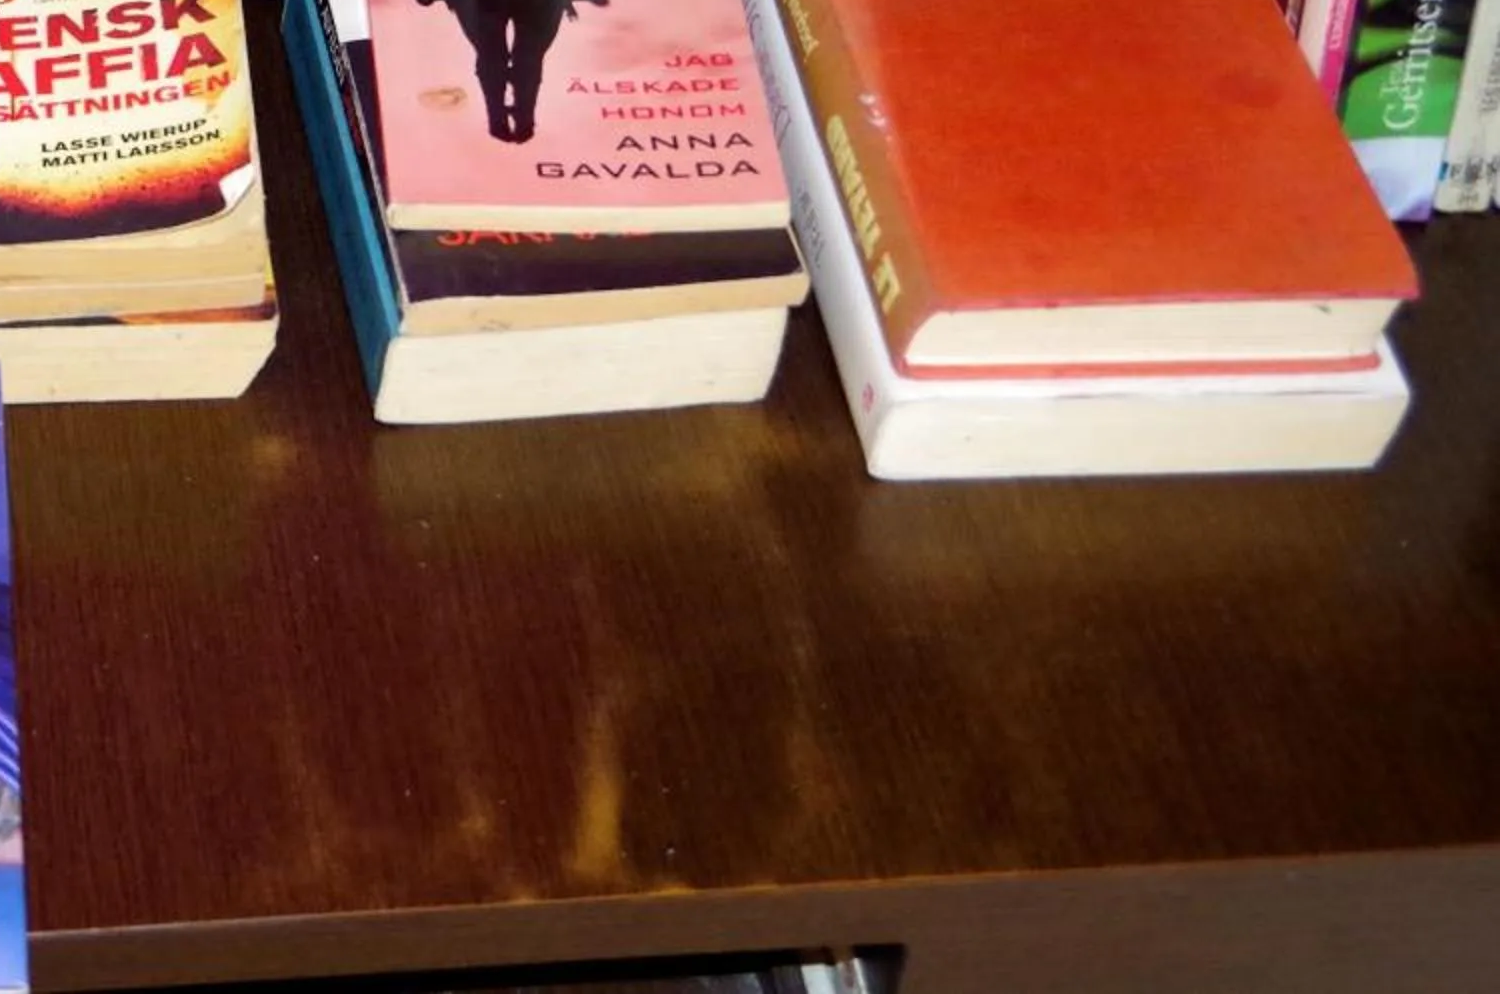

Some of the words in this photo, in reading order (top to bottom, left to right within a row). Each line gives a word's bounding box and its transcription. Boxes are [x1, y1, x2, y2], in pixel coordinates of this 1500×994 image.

[664, 52, 734, 69] JAG
[566, 76, 740, 95] ÄLSKADE
[601, 102, 746, 120] HONOM
[40, 133, 113, 154] LASSE
[121, 118, 208, 143] WIERUP
[616, 131, 755, 151] ANNA
[41, 149, 108, 168] MATTI
[116, 130, 221, 160] LARSSON
[535, 159, 760, 180] GAVALDA
